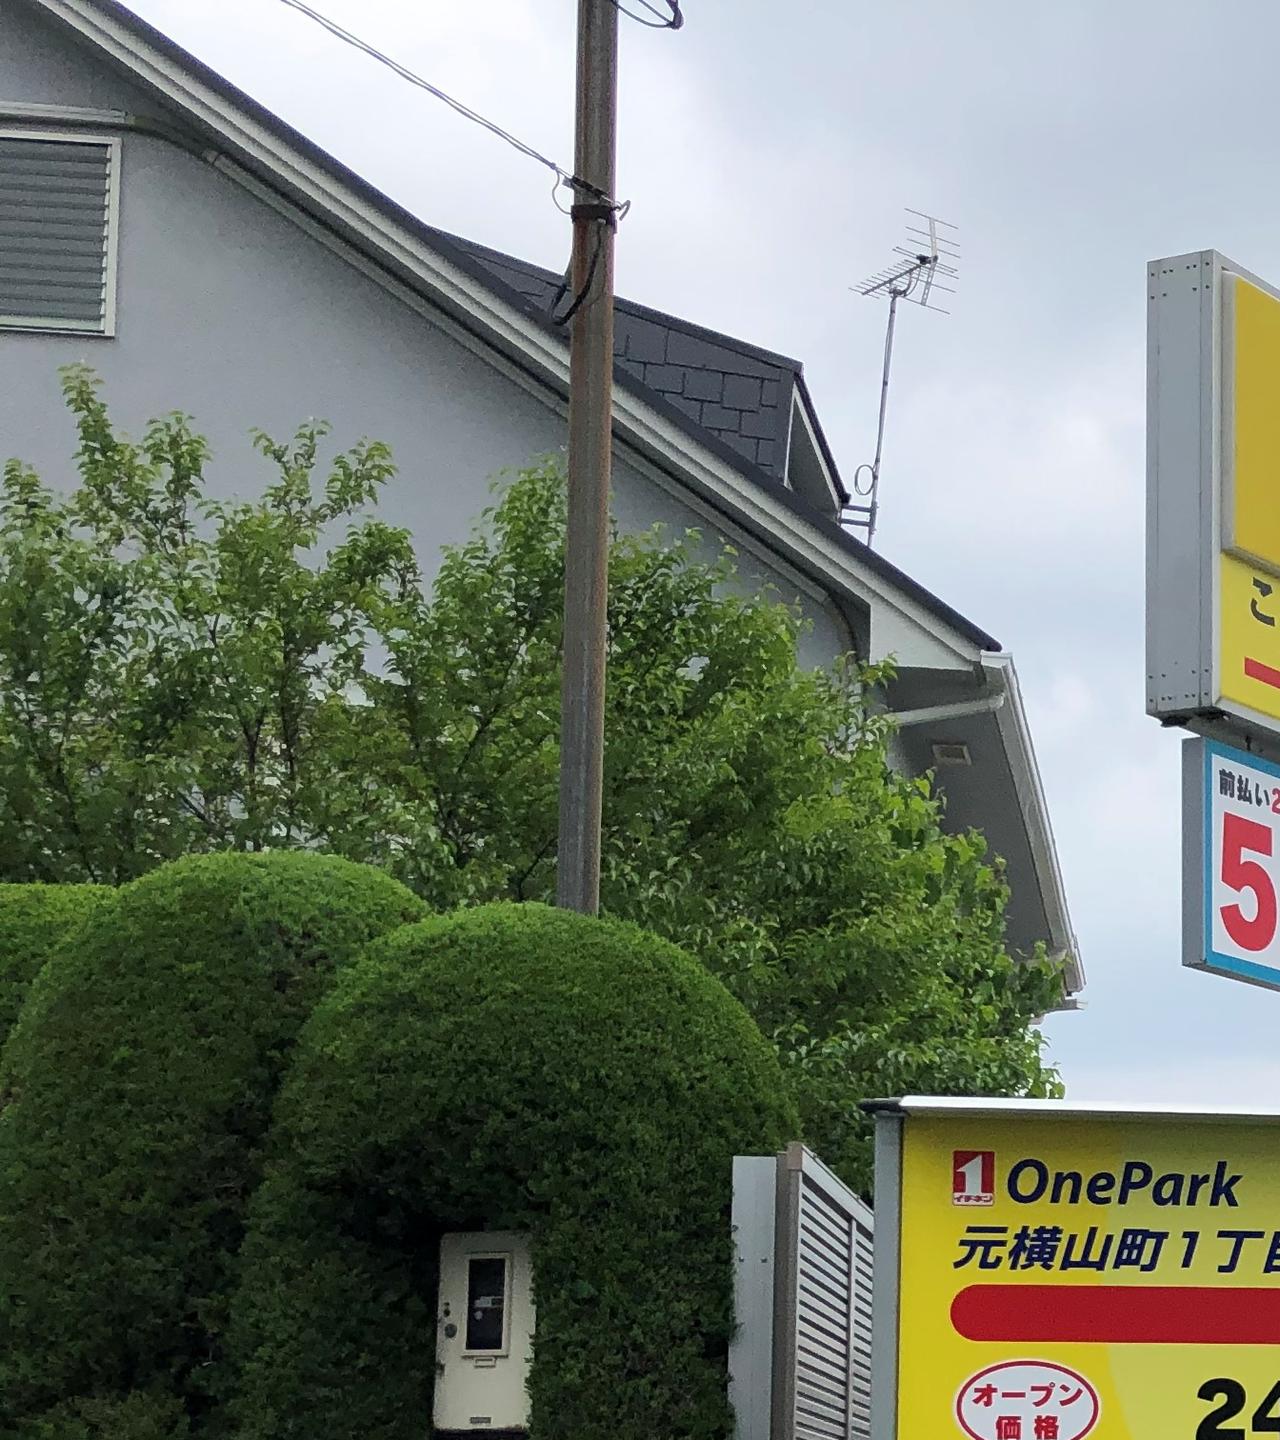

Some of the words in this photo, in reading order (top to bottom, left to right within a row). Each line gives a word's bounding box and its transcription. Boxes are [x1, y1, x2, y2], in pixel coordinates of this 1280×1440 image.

[1007, 1158, 1244, 1208] OnePark
[973, 1382, 1083, 1408] オープン
[996, 1414, 1060, 1440] 価格
